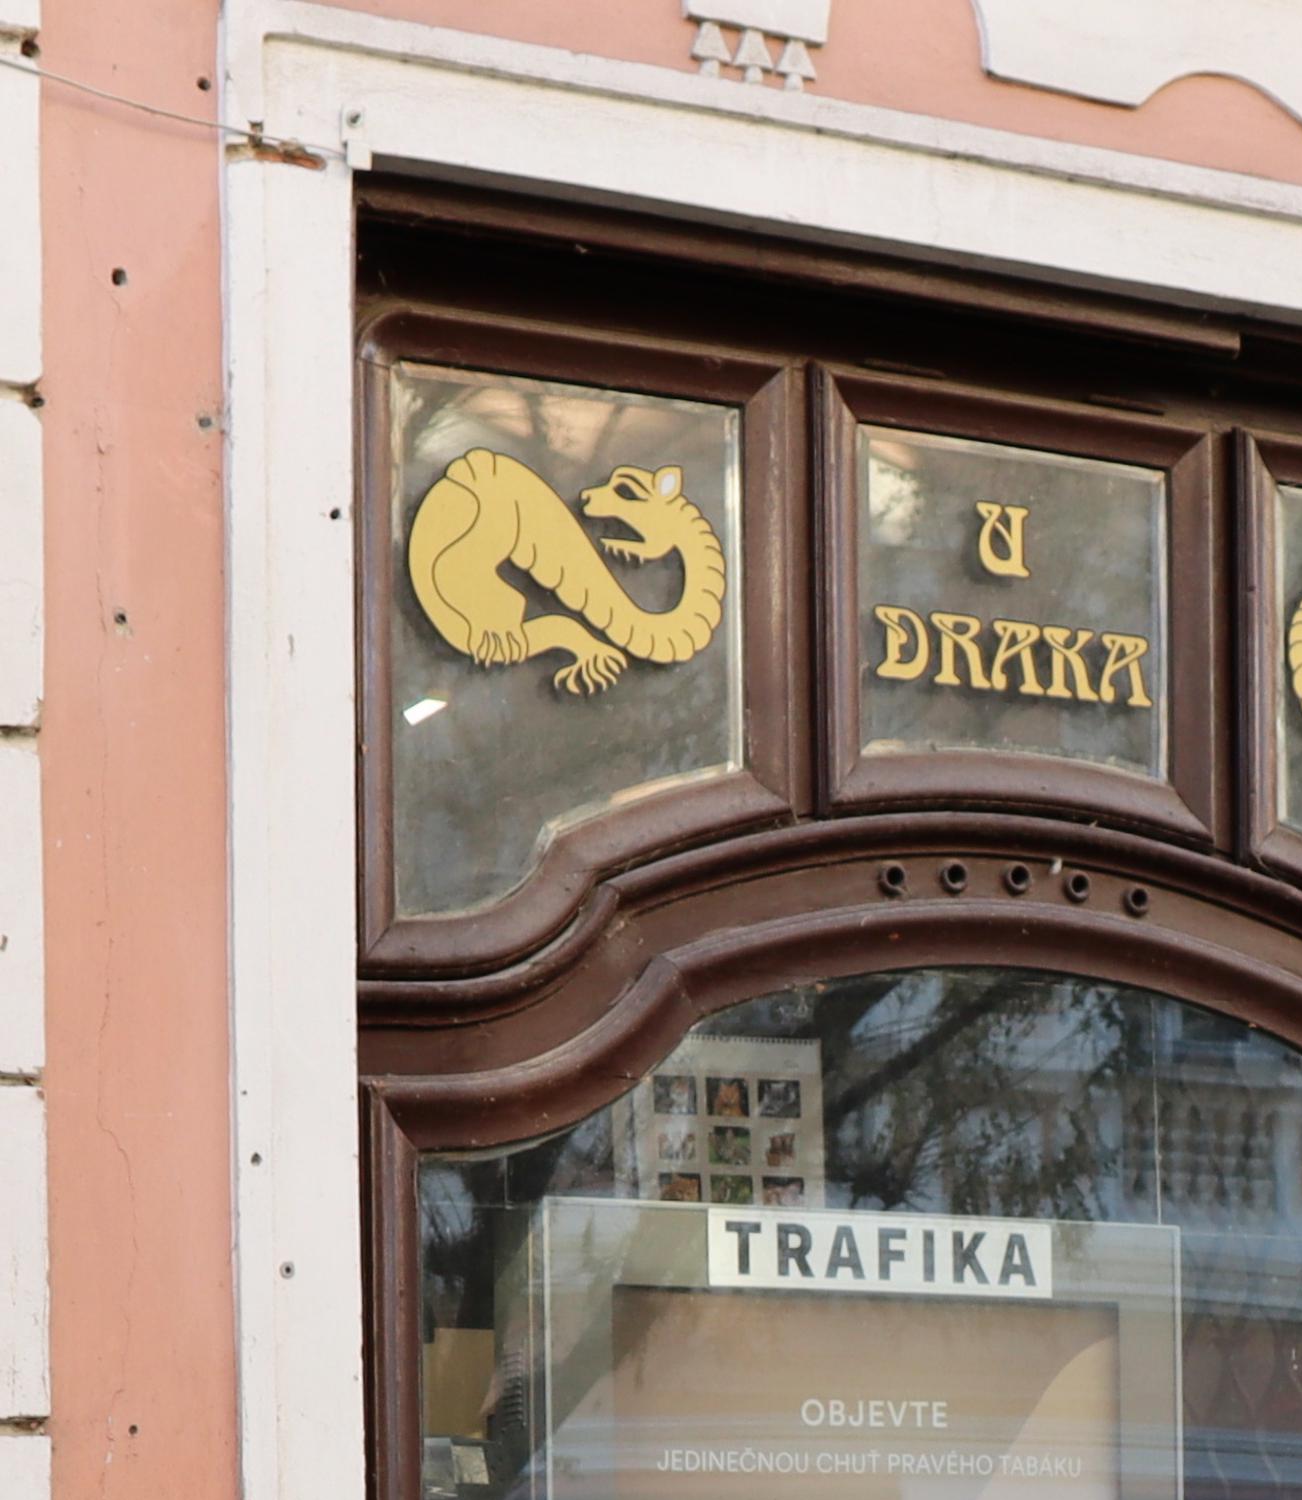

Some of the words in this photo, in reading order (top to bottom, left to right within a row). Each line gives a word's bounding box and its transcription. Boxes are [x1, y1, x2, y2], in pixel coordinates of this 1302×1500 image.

[976, 500, 1030, 579] U
[874, 605, 1152, 708] DRAKA
[725, 1220, 1037, 1287] TRAFIKA
[801, 1398, 948, 1429] OBJEVTE
[657, 1446, 809, 1474] JEDINEČNOU
[816, 1451, 880, 1475] CHUŤ
[888, 1450, 993, 1477] PRAVÉHO
[999, 1452, 1082, 1479] TABÁKU
